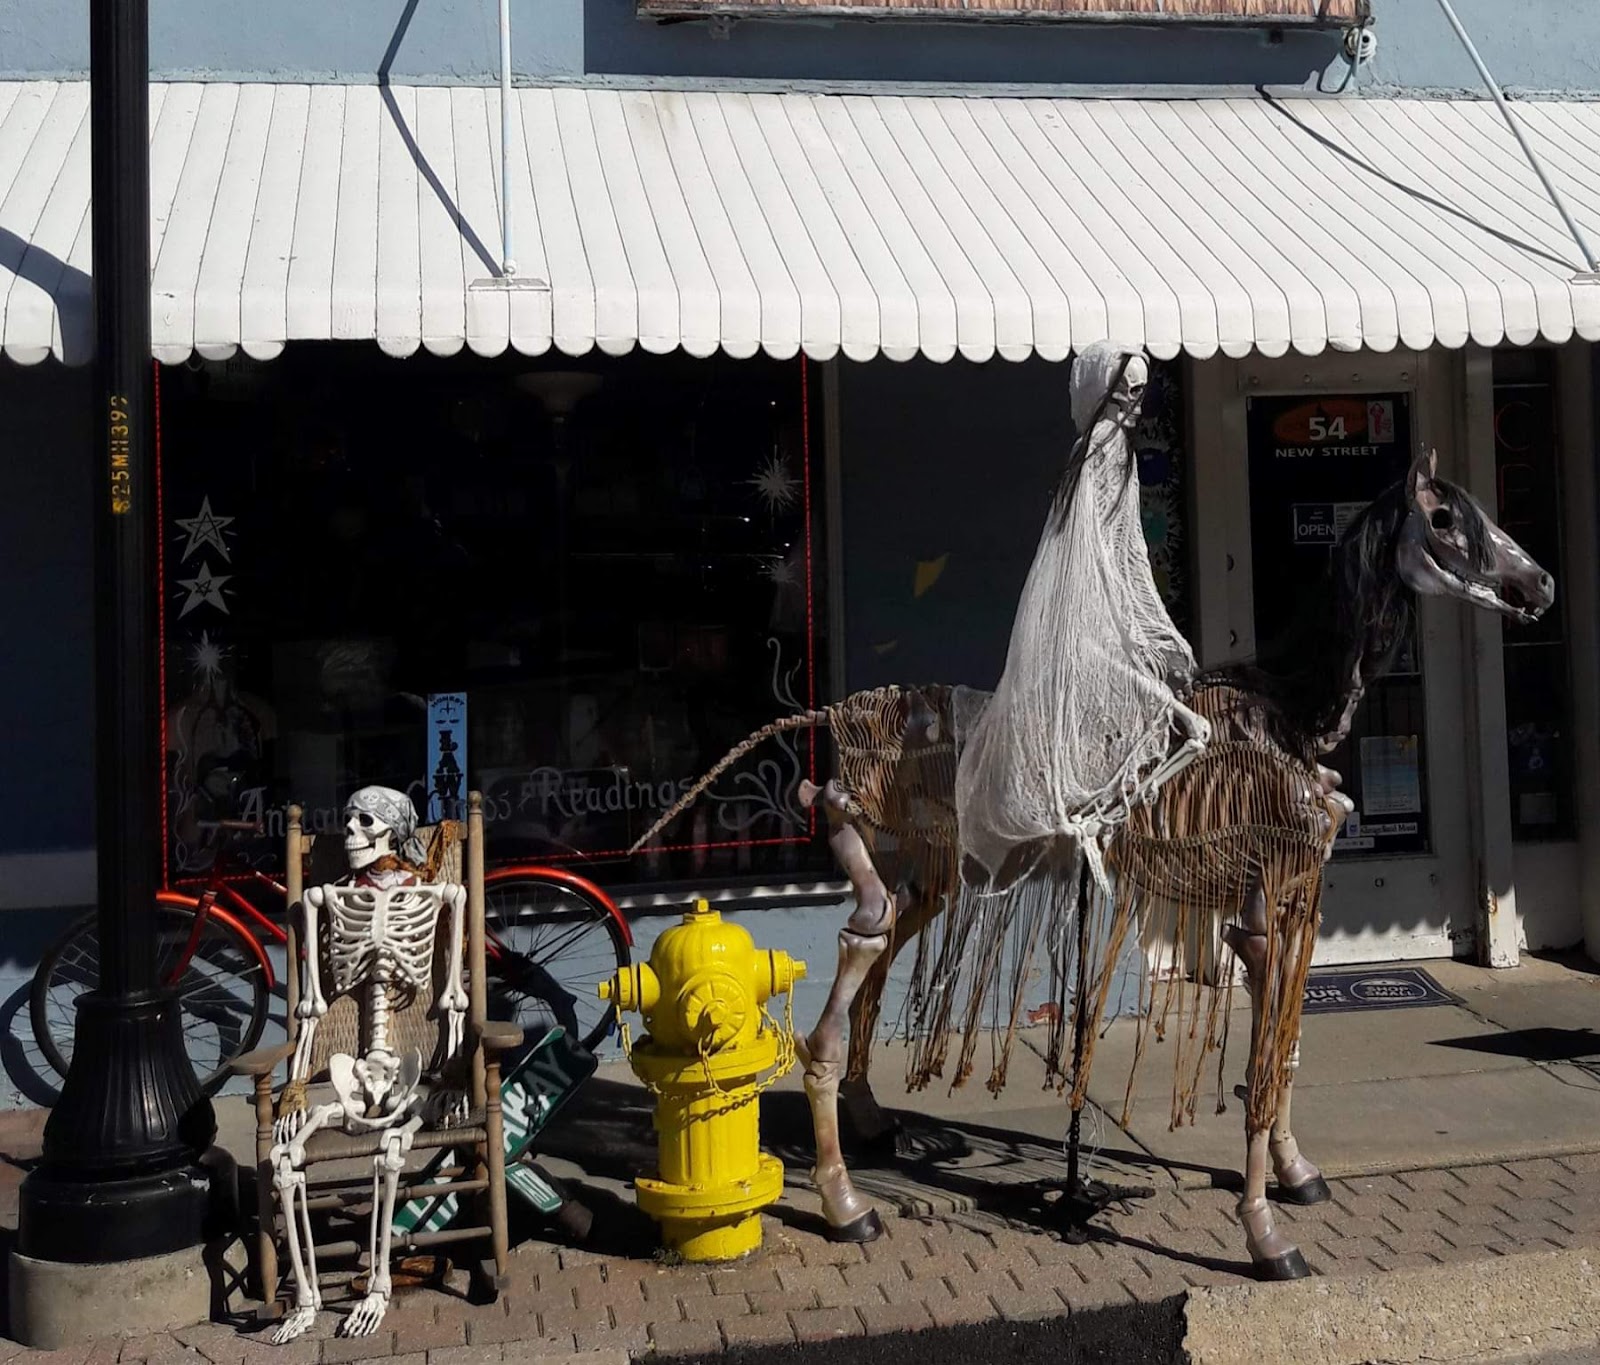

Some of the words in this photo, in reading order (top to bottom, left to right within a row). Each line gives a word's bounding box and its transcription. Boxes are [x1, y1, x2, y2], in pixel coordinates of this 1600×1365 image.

[1308, 416, 1348, 440] 54
[1275, 447, 1315, 459] NEW
[1321, 446, 1380, 457] STREET
[1298, 523, 1335, 537] OPEN
[529, 766, 695, 818] Readings
